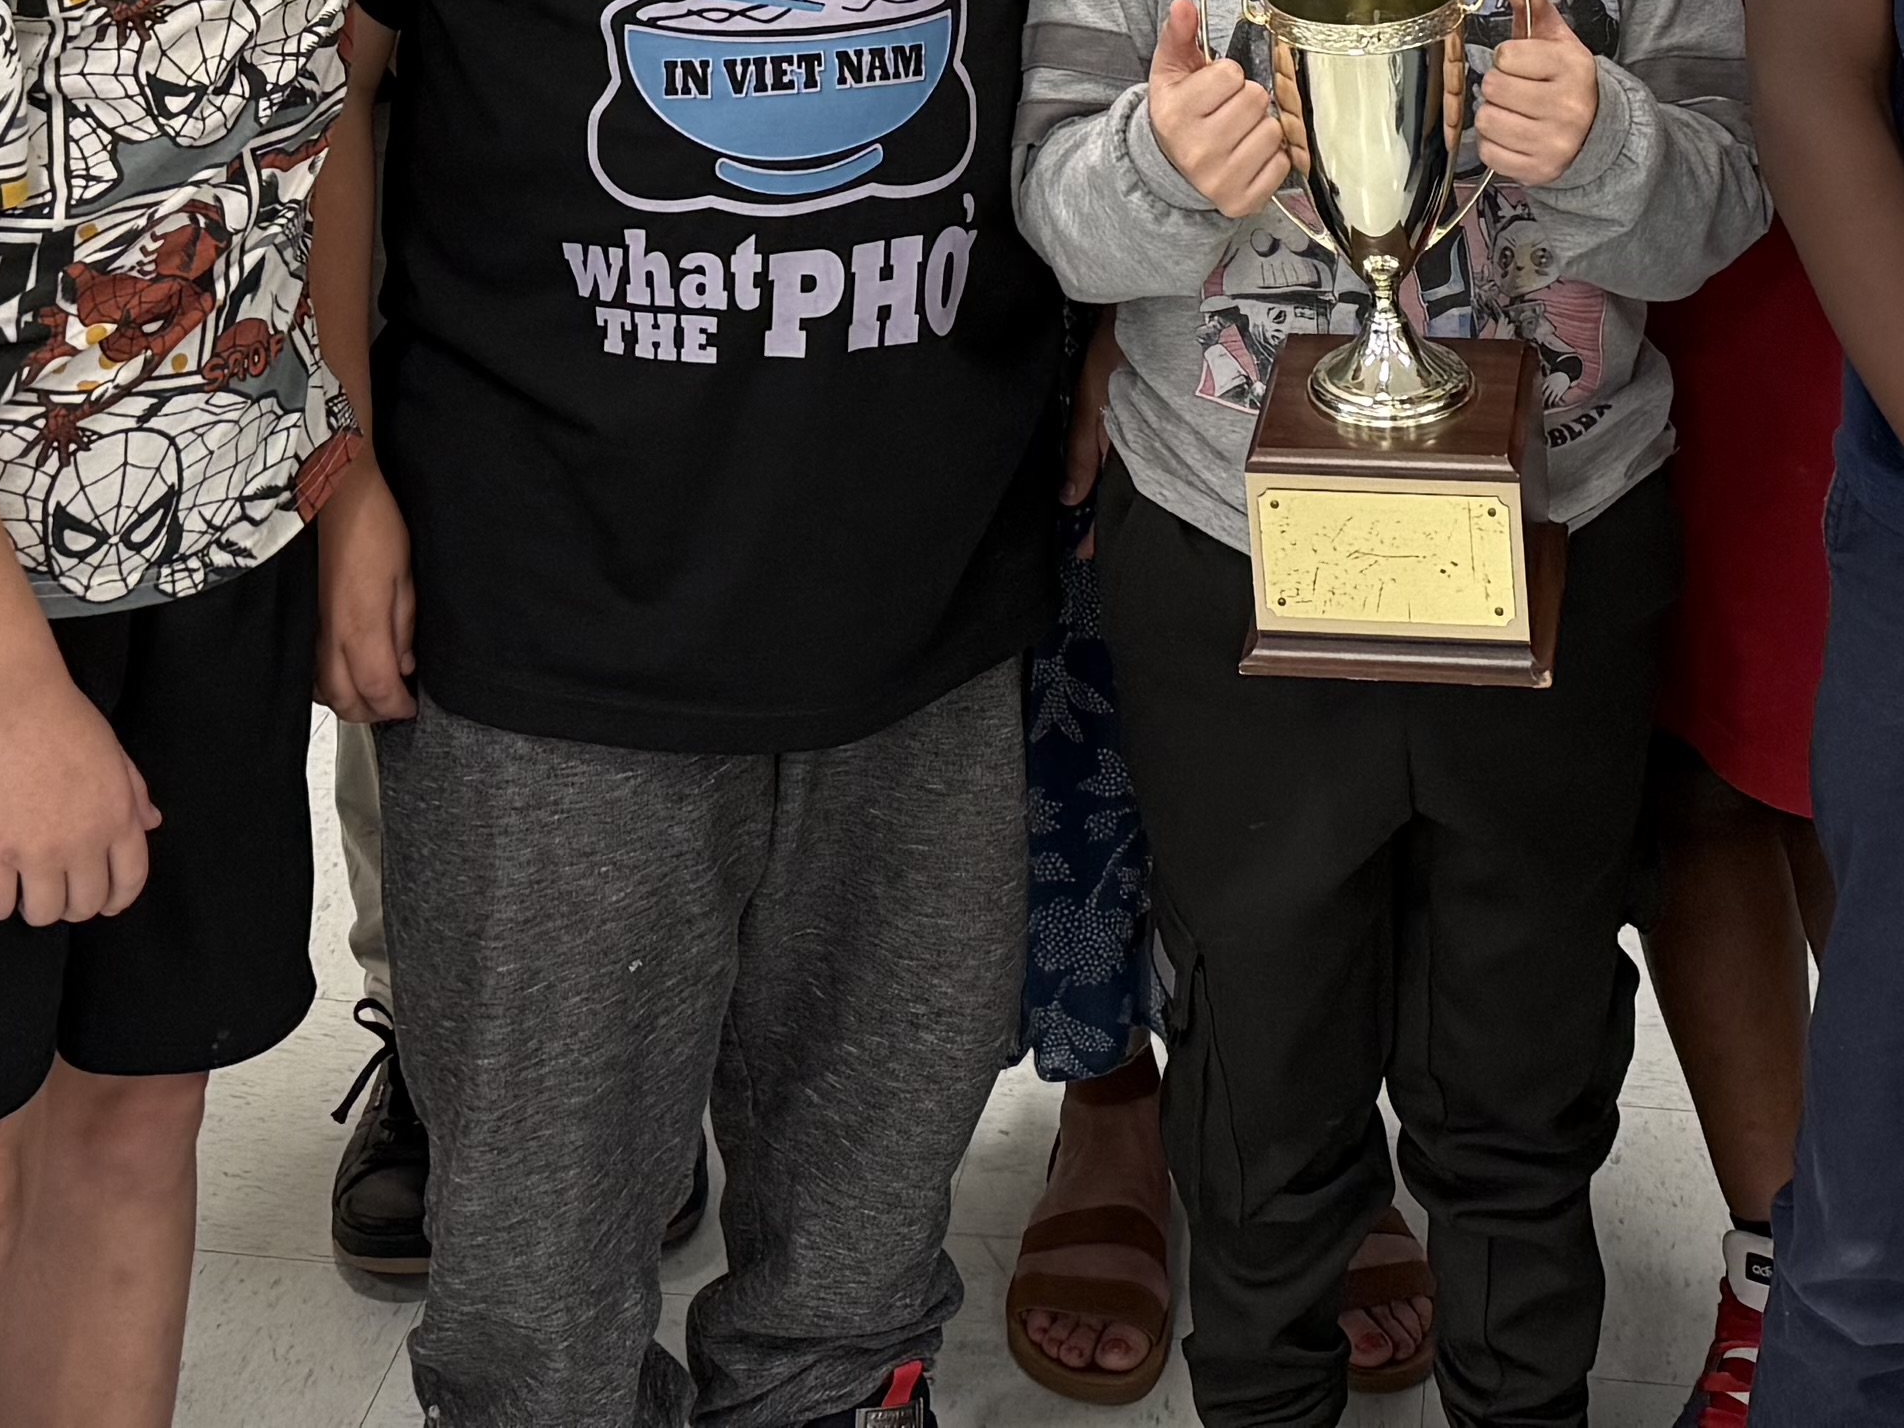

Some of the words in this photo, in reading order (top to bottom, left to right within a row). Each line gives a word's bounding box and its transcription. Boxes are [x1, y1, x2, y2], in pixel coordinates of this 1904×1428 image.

[662, 58, 712, 100] IN
[722, 51, 825, 97] VIET
[835, 43, 926, 89] NAM
[562, 228, 761, 311] what
[596, 306, 718, 365] THE
